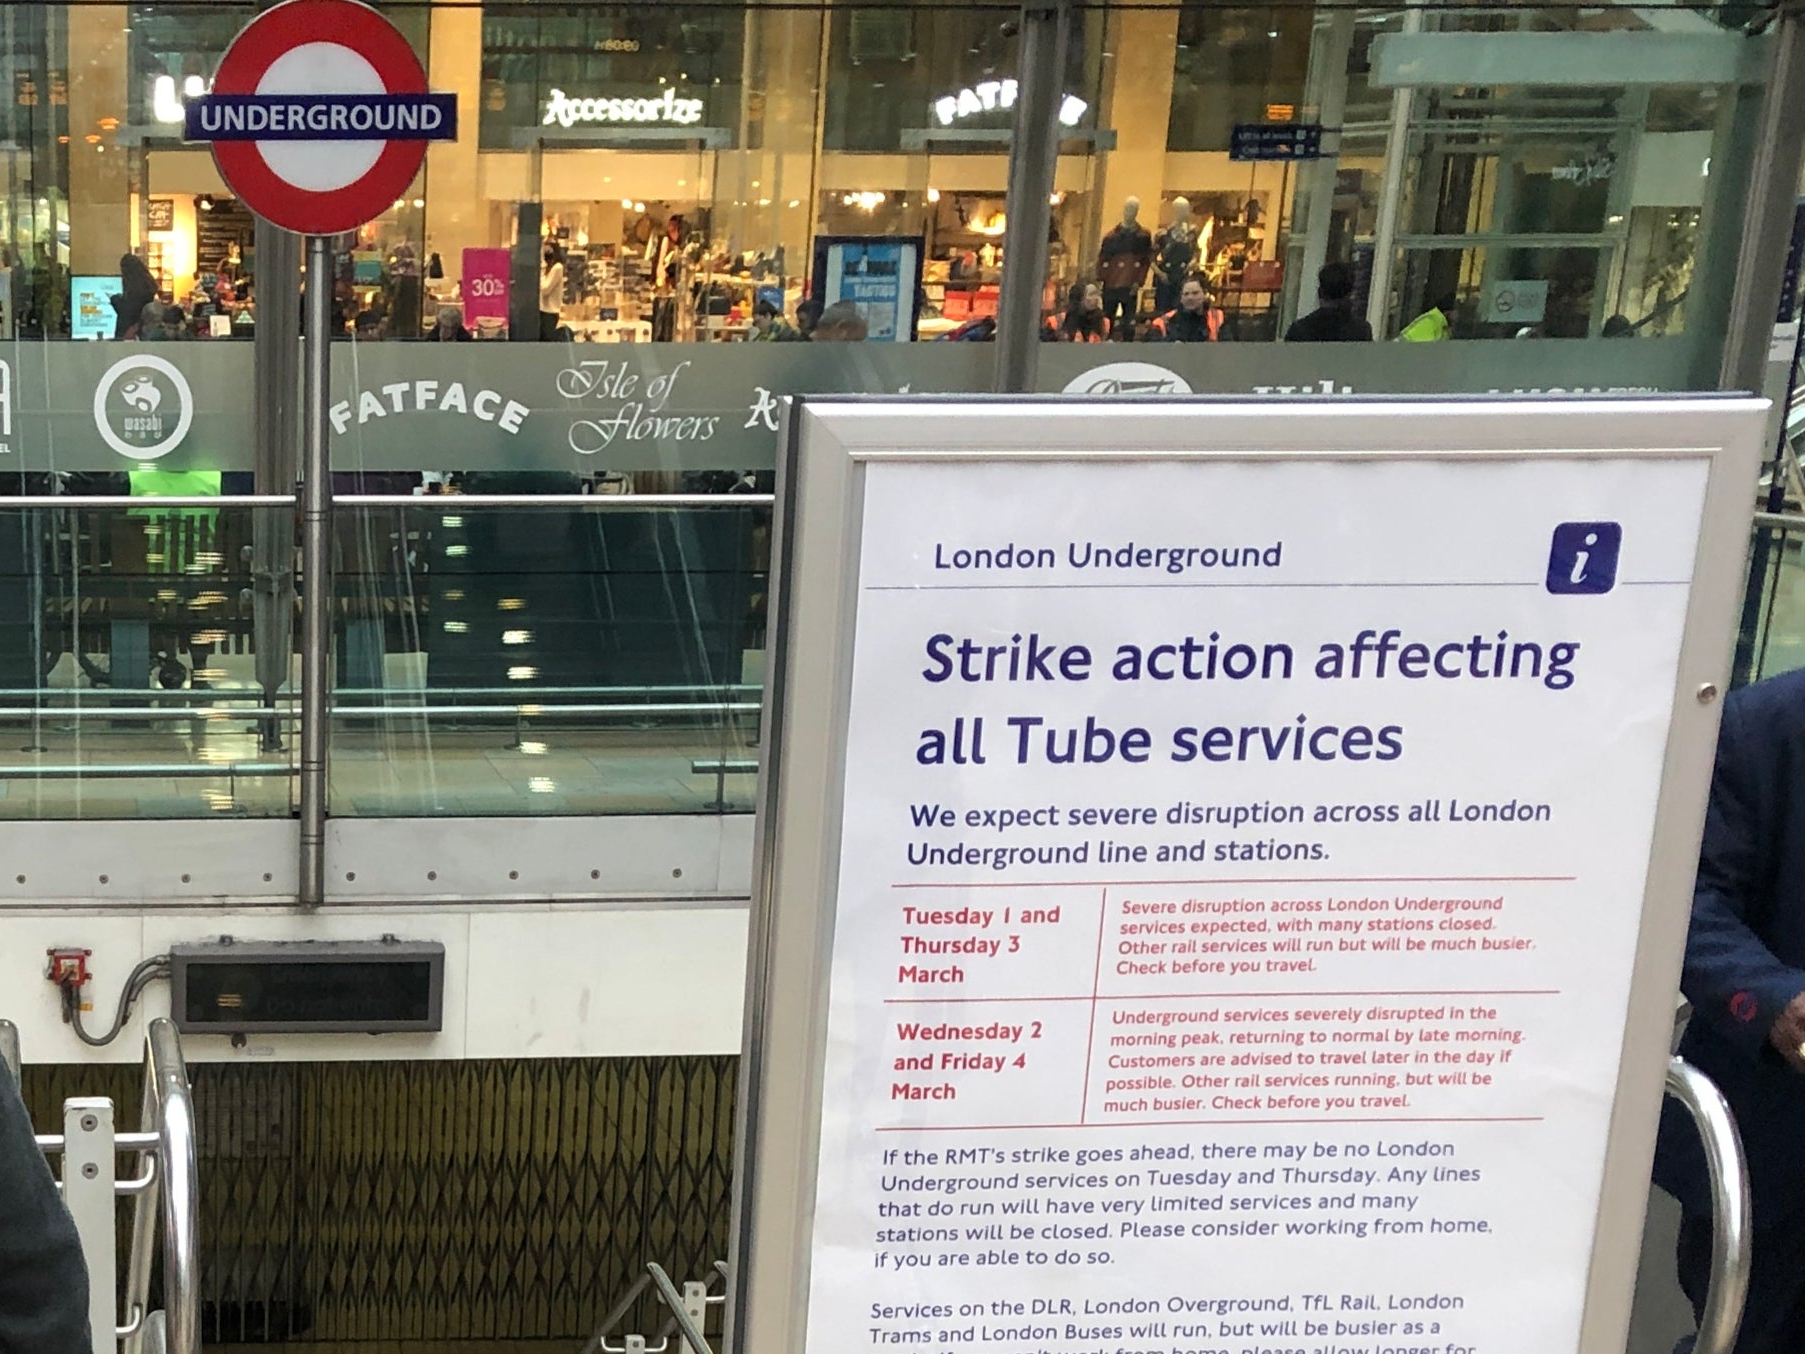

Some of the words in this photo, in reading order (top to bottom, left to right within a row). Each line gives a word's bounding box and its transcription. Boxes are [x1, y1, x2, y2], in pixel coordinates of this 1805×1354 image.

[201, 104, 443, 131] UNDERGROUND
[542, 87, 703, 127] Accessorize
[556, 360, 639, 399] Isle
[646, 360, 692, 413] of
[329, 380, 530, 434] FATFACE
[124, 413, 162, 431] wasabi
[568, 402, 720, 454] Flowers
[935, 543, 1055, 569] London
[1069, 541, 1282, 574] Underground
[922, 633, 1092, 683] Strike
[1112, 631, 1293, 681] action
[1315, 629, 1581, 690] affecting
[916, 717, 986, 765] all
[1007, 716, 1151, 764] Tube
[1171, 713, 1403, 762] services
[910, 804, 956, 827] We
[965, 805, 1060, 832] expect
[1068, 808, 1157, 826] severe
[1166, 800, 1304, 829] disruption
[1313, 805, 1399, 823] across
[1408, 799, 1440, 822] all
[1449, 799, 1551, 821] London
[908, 841, 1089, 870] Underground
[1099, 840, 1147, 863] line
[1156, 839, 1205, 862] and
[903, 907, 994, 928] Tuesday
[1020, 905, 1060, 923] and
[1122, 900, 1176, 914] Severe
[1182, 899, 1265, 916] disruption
[1271, 901, 1322, 912] across
[1328, 897, 1389, 911] London
[1395, 896, 1503, 914] Underground
[1120, 920, 1185, 935] services
[1277, 918, 1312, 932] with
[1318, 920, 1363, 934] many
[1367, 917, 1433, 931] stations
[901, 936, 1001, 958] Thursday
[1008, 935, 1020, 953] 3
[1119, 941, 1167, 955] Other
[1172, 939, 1196, 953] rail
[1202, 939, 1267, 953] services
[1273, 938, 1301, 952] will
[1306, 941, 1333, 951] run
[1339, 938, 1367, 951] but
[1372, 937, 1400, 951] will
[1406, 937, 1426, 951] be
[1431, 937, 1476, 950] much
[899, 965, 964, 983] March
[1116, 960, 1166, 975] Check
[1172, 959, 1225, 974] before
[1230, 962, 1260, 975] you
[897, 1022, 1023, 1043] Wednesday
[1031, 1021, 1042, 1038] 2
[894, 1053, 934, 1071] and
[941, 1052, 1006, 1073] Friday
[1012, 1053, 1026, 1069] 4
[892, 1083, 955, 1100] March
[883, 1149, 898, 1165] If
[904, 1149, 938, 1165] the
[946, 1148, 1005, 1164] RMT's
[1012, 1147, 1070, 1163] strike
[1075, 1149, 1123, 1166] goes
[1202, 1143, 1256, 1159] there
[1264, 1145, 1307, 1161] may
[1313, 1142, 1337, 1157] be
[1344, 1145, 1370, 1157] no
[1377, 1141, 1454, 1156] London
[882, 1173, 1019, 1194] Underground
[1025, 1173, 1108, 1188] services
[1115, 1175, 1140, 1187] on
[1147, 1169, 1231, 1188] Tuesday
[1238, 1168, 1275, 1184] and
[1387, 1167, 1427, 1185] Any
[1433, 1166, 1480, 1182] lines
